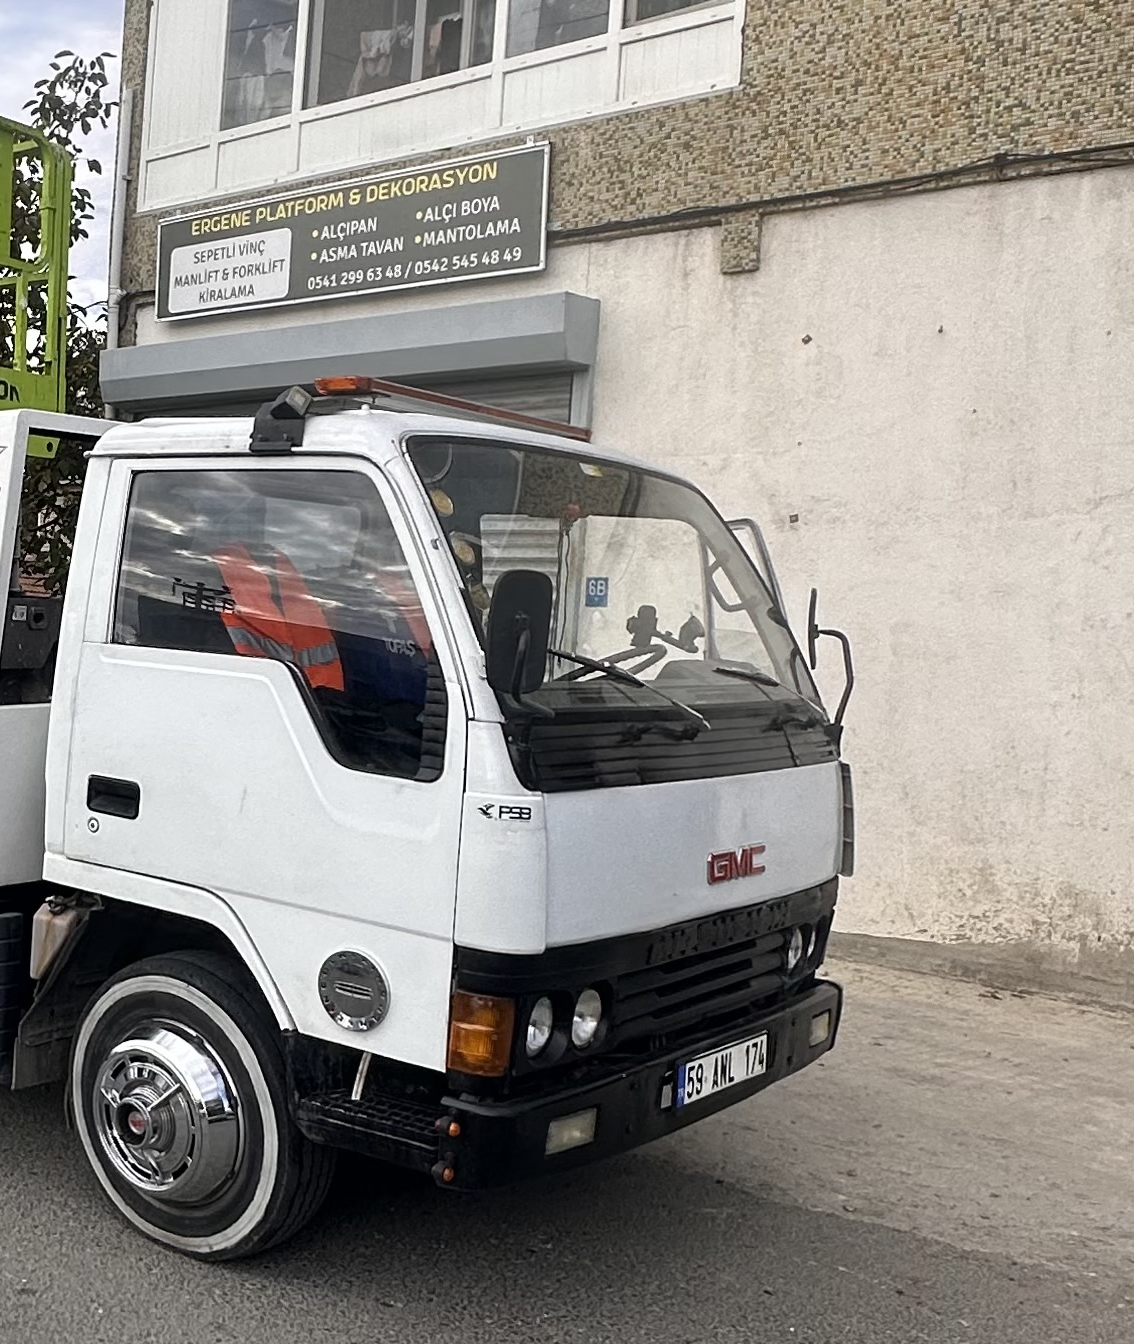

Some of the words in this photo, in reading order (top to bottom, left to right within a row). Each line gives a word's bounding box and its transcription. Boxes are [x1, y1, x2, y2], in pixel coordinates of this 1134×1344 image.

[191, 210, 252, 236] ERGENE
[255, 191, 344, 224] PLATFORM
[348, 188, 362, 205] &
[366, 161, 498, 203] DEKORASYON
[423, 203, 457, 223] ALÇI
[461, 195, 500, 217] BOYA
[320, 217, 378, 242] ALÇIPAN
[422, 217, 521, 247] MANTOLAMA
[193, 245, 236, 265] SEPETLİ
[238, 239, 266, 257] VİNÇ
[319, 244, 358, 264] ASMA
[360, 236, 404, 258] TAVAN
[174, 268, 220, 289] MANLİFT
[221, 268, 229, 281] &
[232, 258, 286, 279] FORKLİFT
[307, 273, 337, 290] 0541
[341, 269, 364, 286] 299
[366, 266, 383, 282] 63
[385, 263, 402, 278] 48
[404, 260, 413, 278] /
[415, 257, 449, 275] 0542
[452, 252, 478, 269] 545
[481, 249, 500, 265] 48
[503, 246, 522, 262] 49
[198, 284, 255, 304] KİRALAMA
[588, 579, 606, 596] 6B
[707, 841, 766, 885] GMC
[686, 1062, 704, 1099] 59
[711, 1051, 735, 1090] ANL
[746, 1039, 765, 1076] 174
